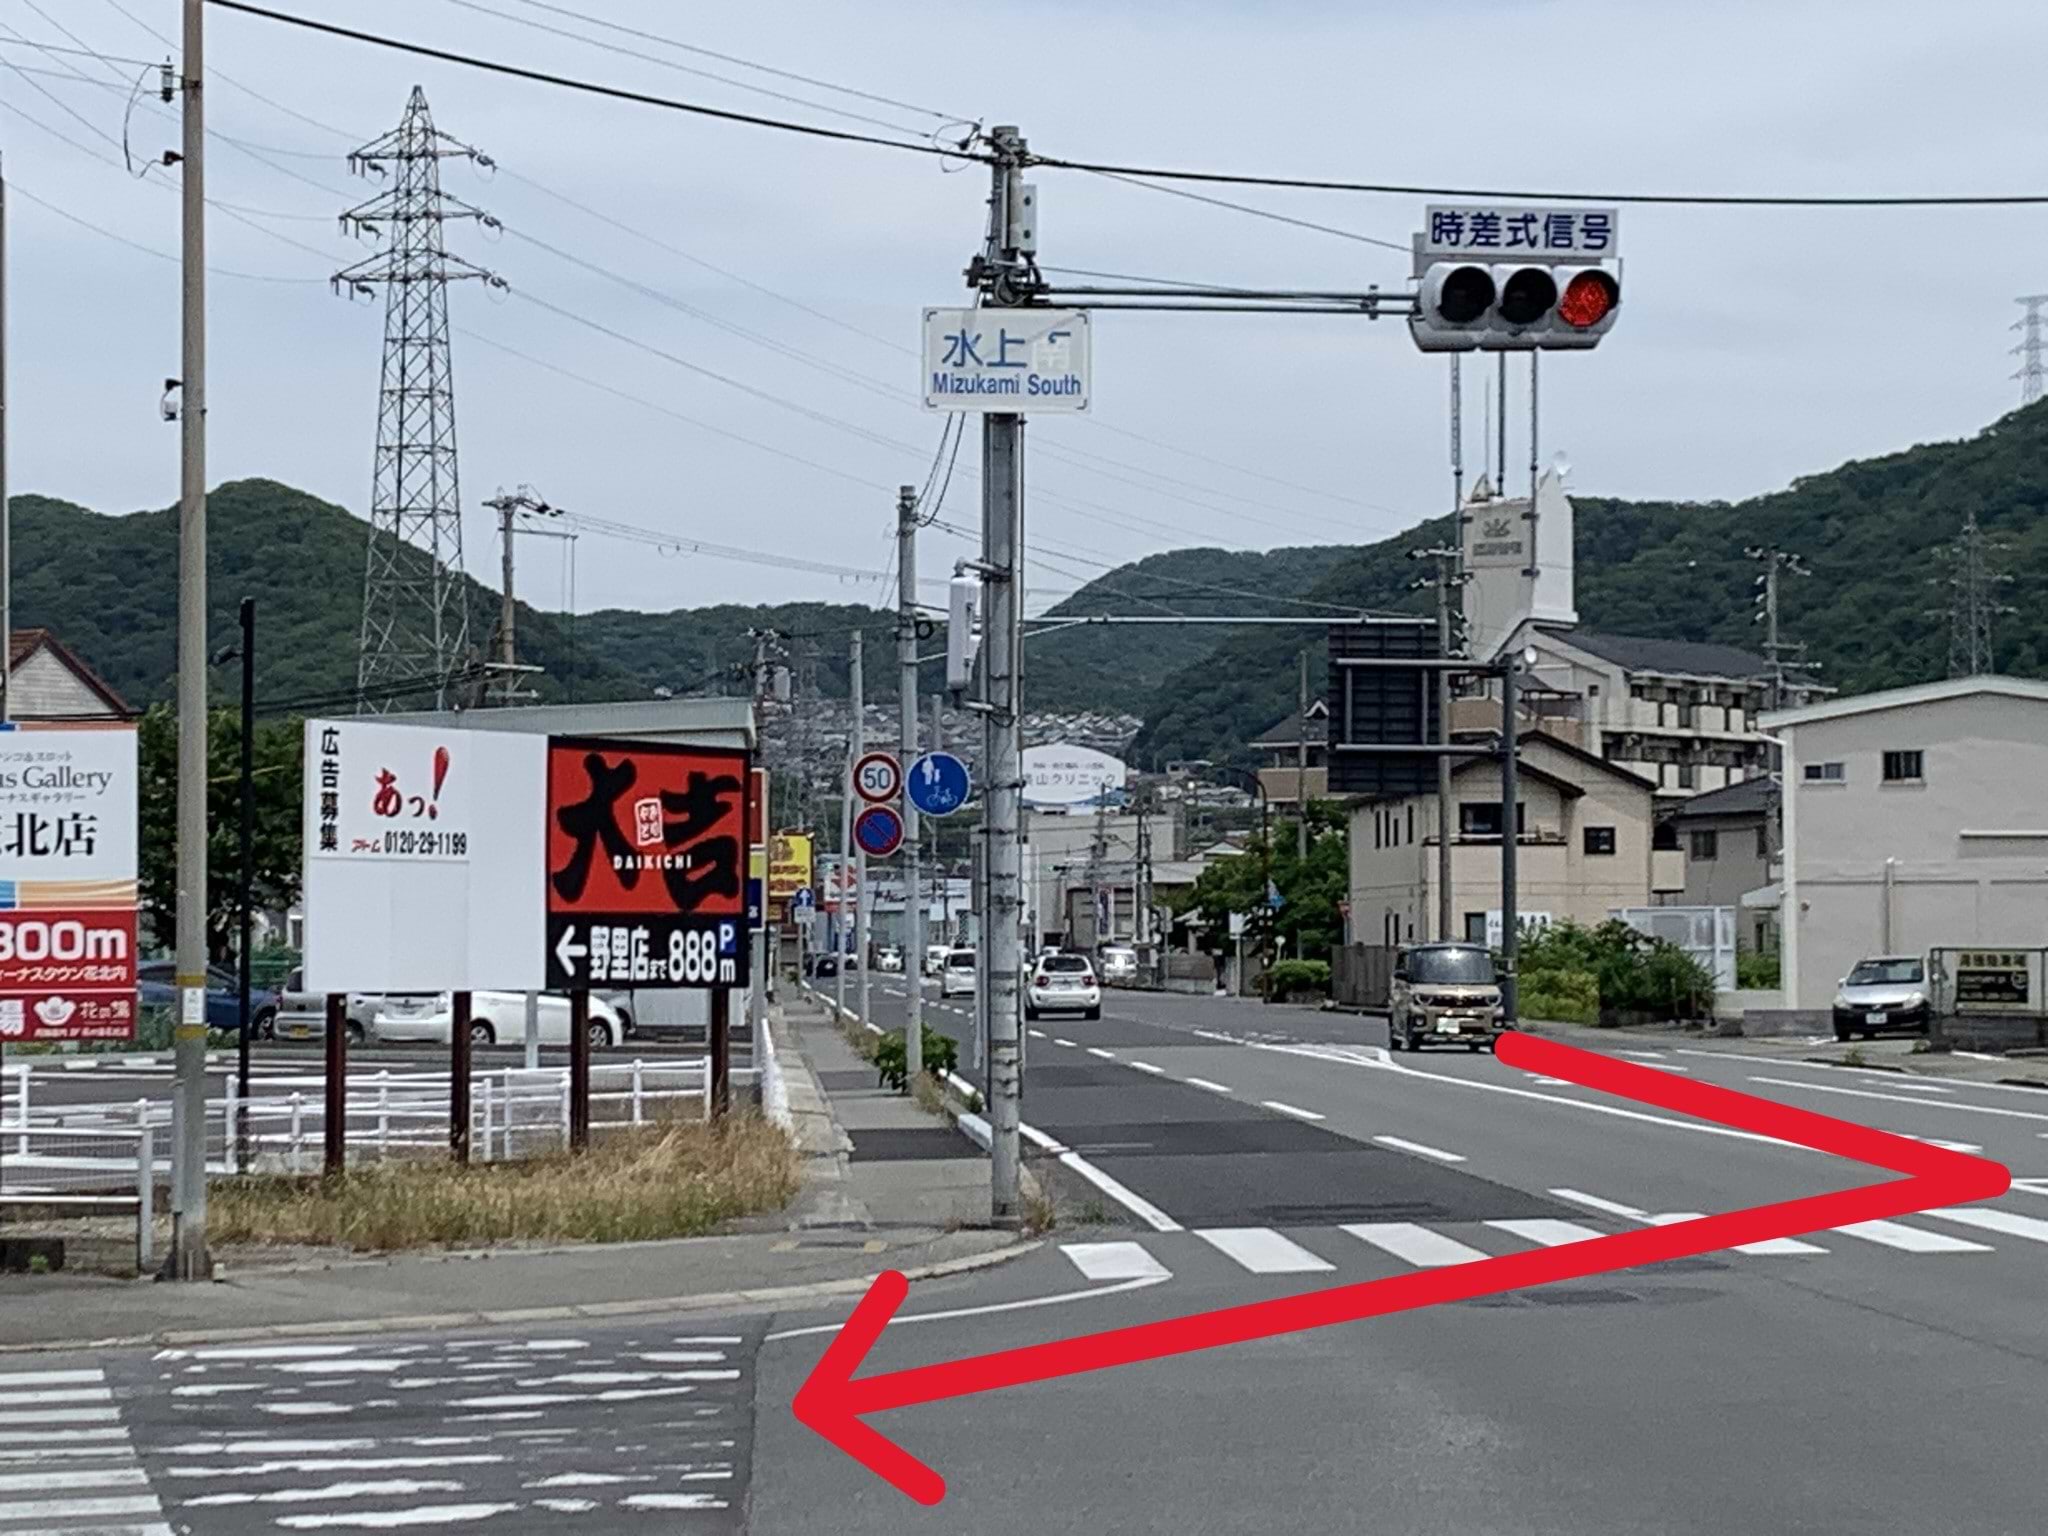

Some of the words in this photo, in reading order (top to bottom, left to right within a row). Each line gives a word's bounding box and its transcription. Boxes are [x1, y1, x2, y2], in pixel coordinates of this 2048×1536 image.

[1431, 211, 1611, 250] 時差式信号
[932, 372, 1021, 394] Mizukami
[1027, 373, 1082, 395] South
[22, 765, 113, 796] Gallery
[320, 726, 340, 851] 広告募集
[863, 766, 891, 790] 50
[0, 811, 98, 857] 北店
[384, 830, 468, 856] 0120-29-1199
[552, 752, 743, 912] 大吉
[613, 854, 692, 870] DAIKICHI
